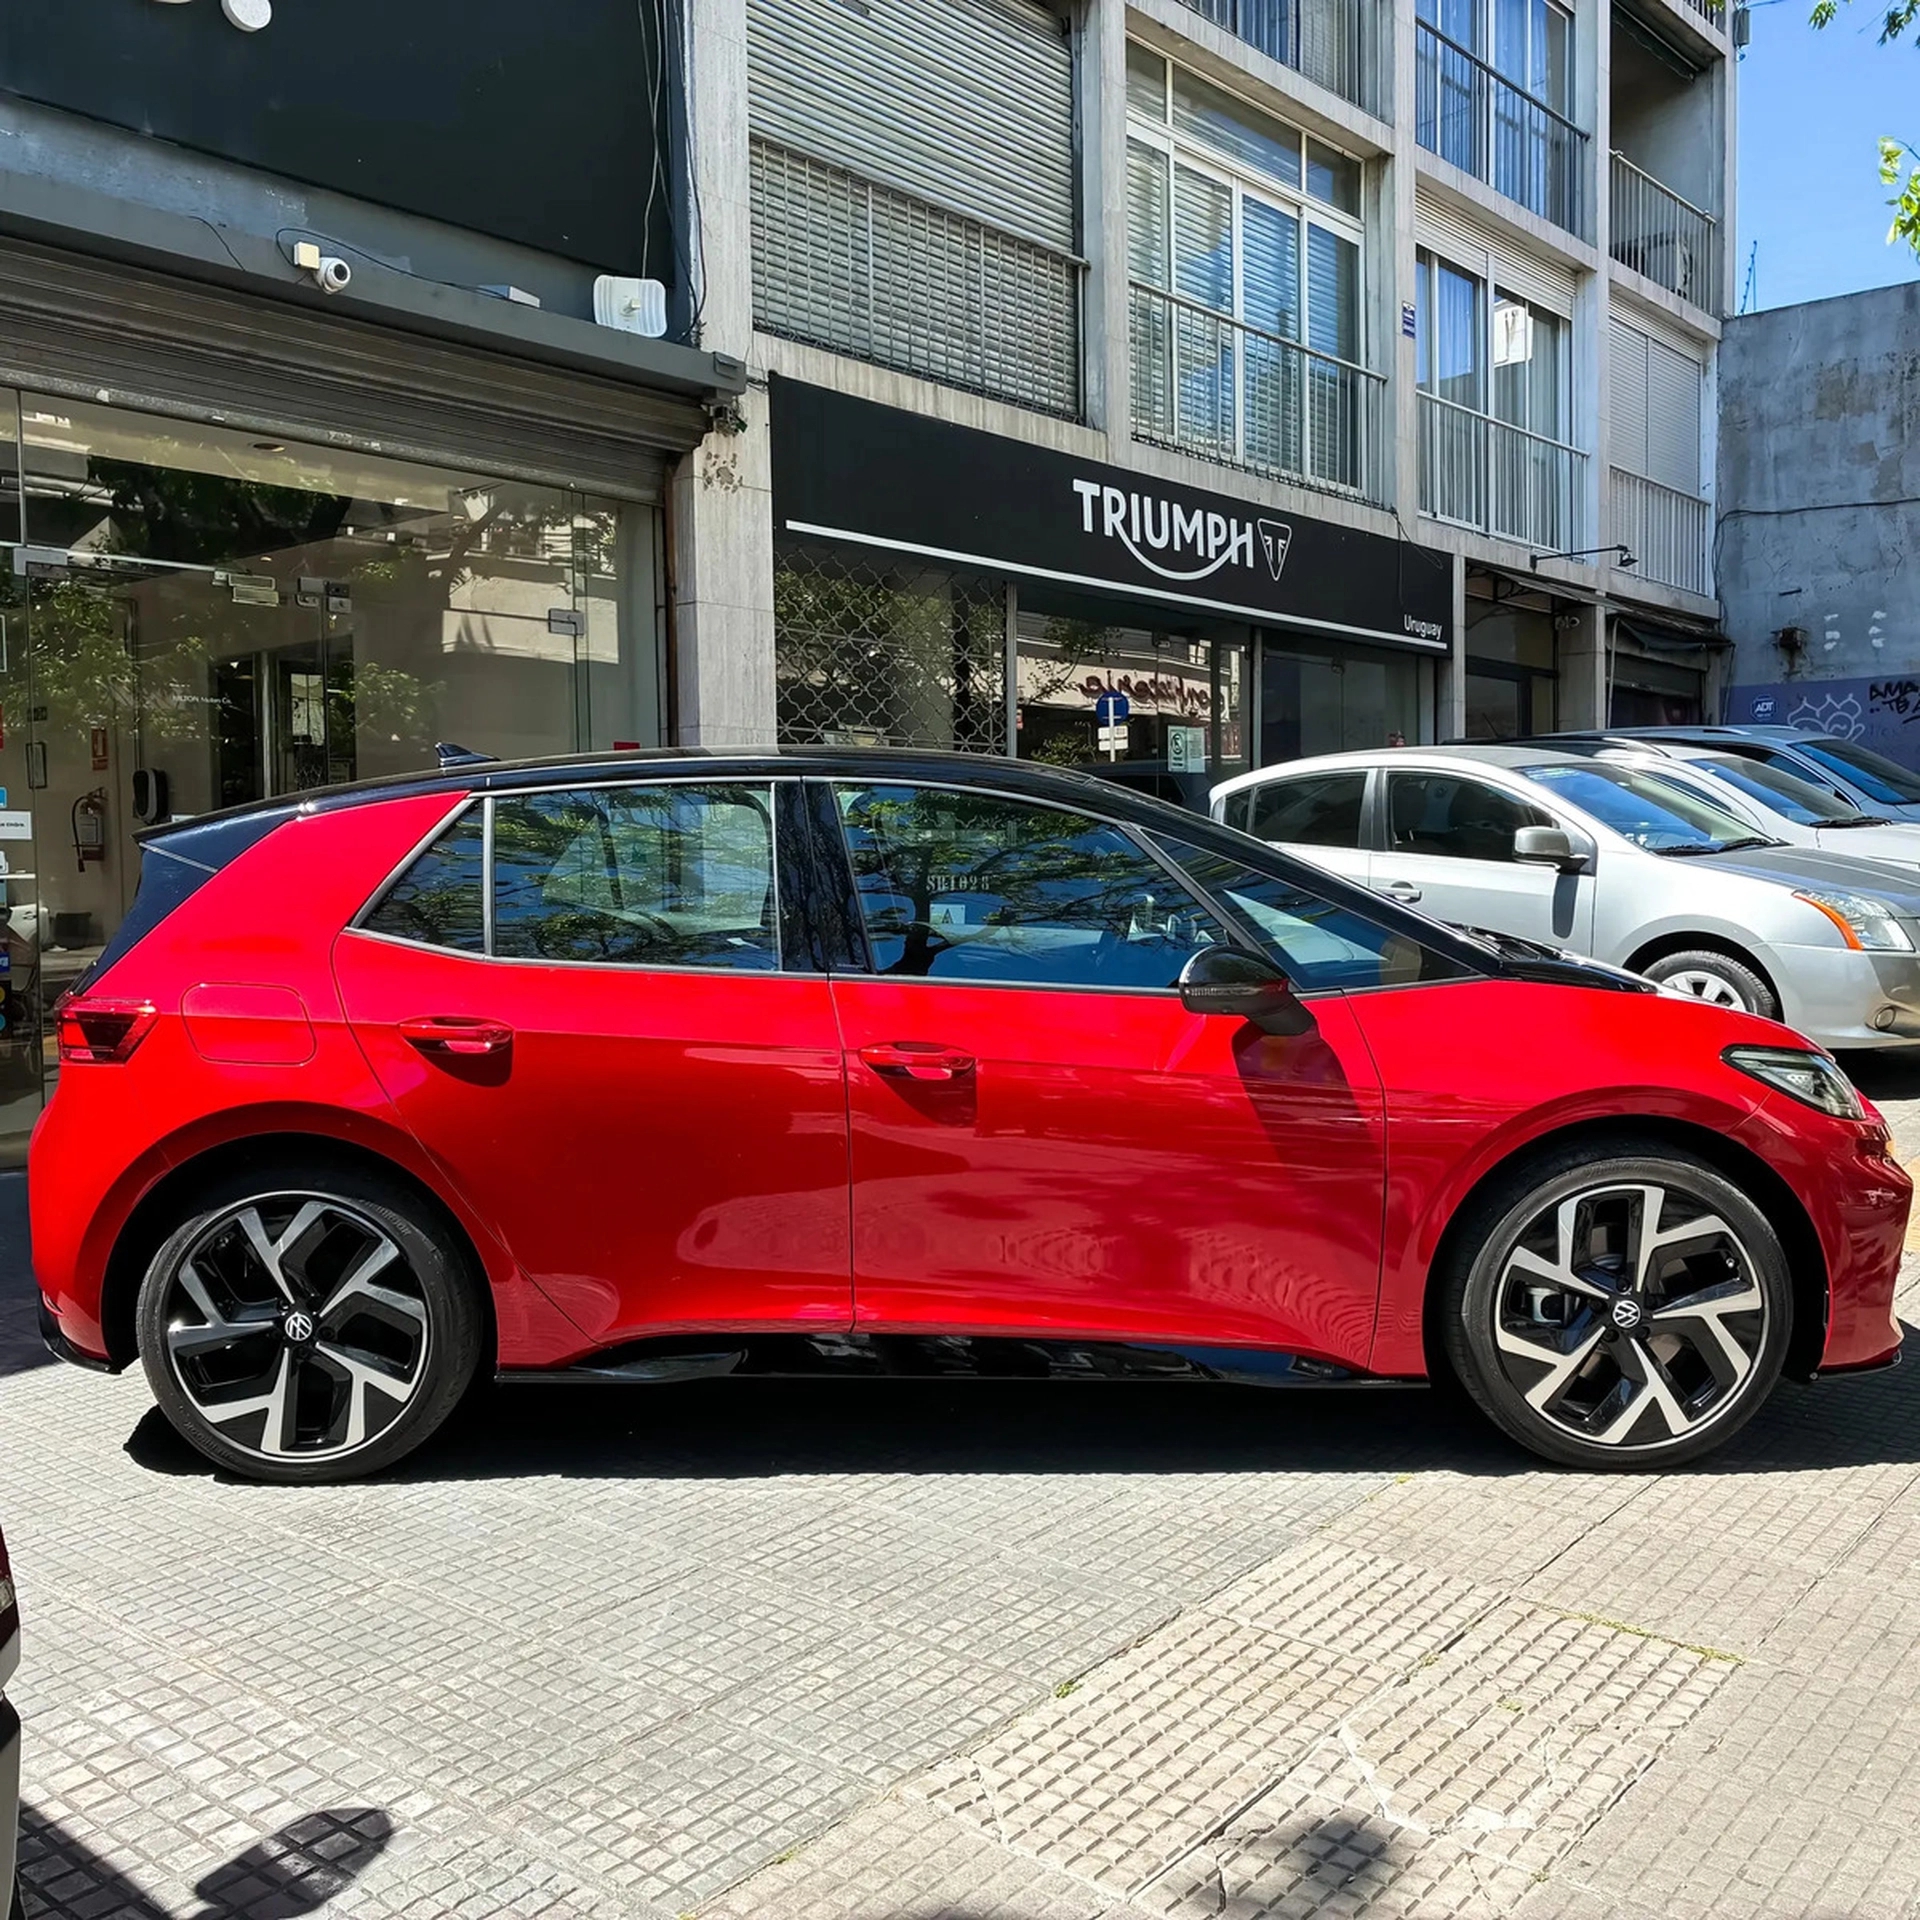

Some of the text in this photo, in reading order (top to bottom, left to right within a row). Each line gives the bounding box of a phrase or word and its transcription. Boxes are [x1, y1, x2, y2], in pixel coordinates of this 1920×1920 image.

[1073, 478, 1254, 580] TRIUMPH
[1403, 613, 1442, 640] Uruguay
[1755, 702, 1773, 713] ADT
